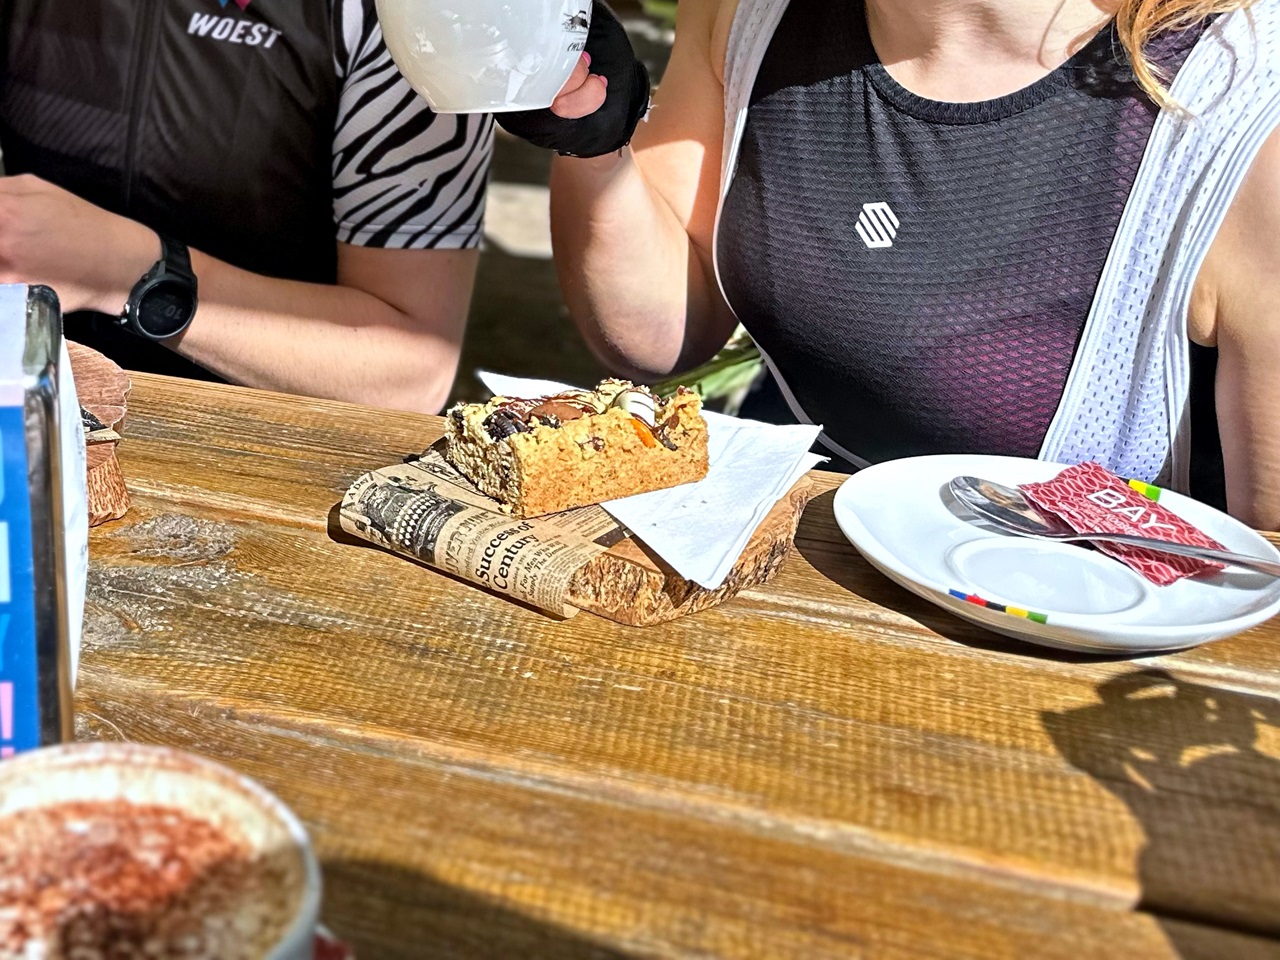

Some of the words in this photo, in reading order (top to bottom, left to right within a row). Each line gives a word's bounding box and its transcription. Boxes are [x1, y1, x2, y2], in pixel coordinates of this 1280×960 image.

[187, 12, 282, 49] WOEST
[1086, 489, 1176, 531] BAY
[475, 525, 520, 583] Success
[519, 520, 535, 532] of
[493, 534, 540, 590] Century
[524, 557, 538, 573] Men
